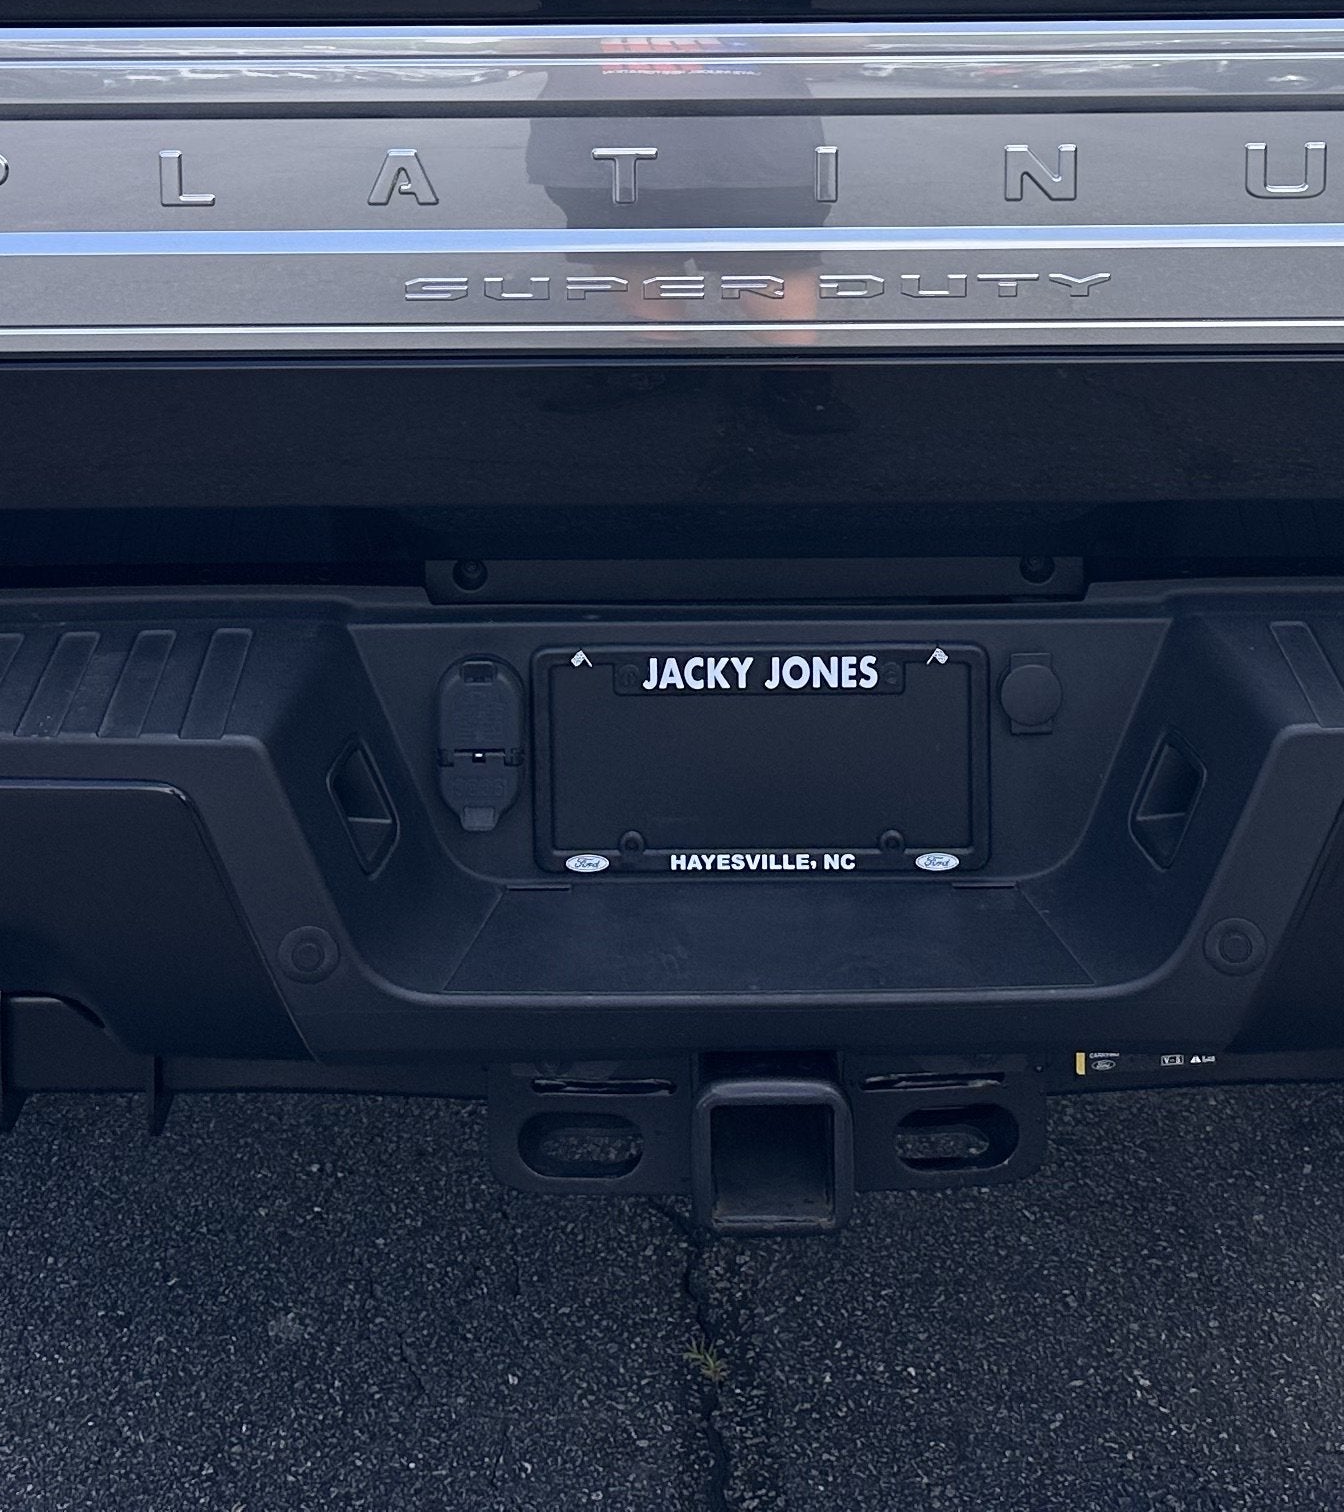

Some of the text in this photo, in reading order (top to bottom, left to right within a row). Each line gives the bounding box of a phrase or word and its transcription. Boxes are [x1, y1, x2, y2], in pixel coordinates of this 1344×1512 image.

[404, 273, 1112, 301] SUPER DUTY
[642, 655, 879, 690] JACKY JONES
[571, 856, 604, 870] Ford
[670, 853, 856, 871] HAYESVILLE, NC
[920, 855, 953, 869] Ford
